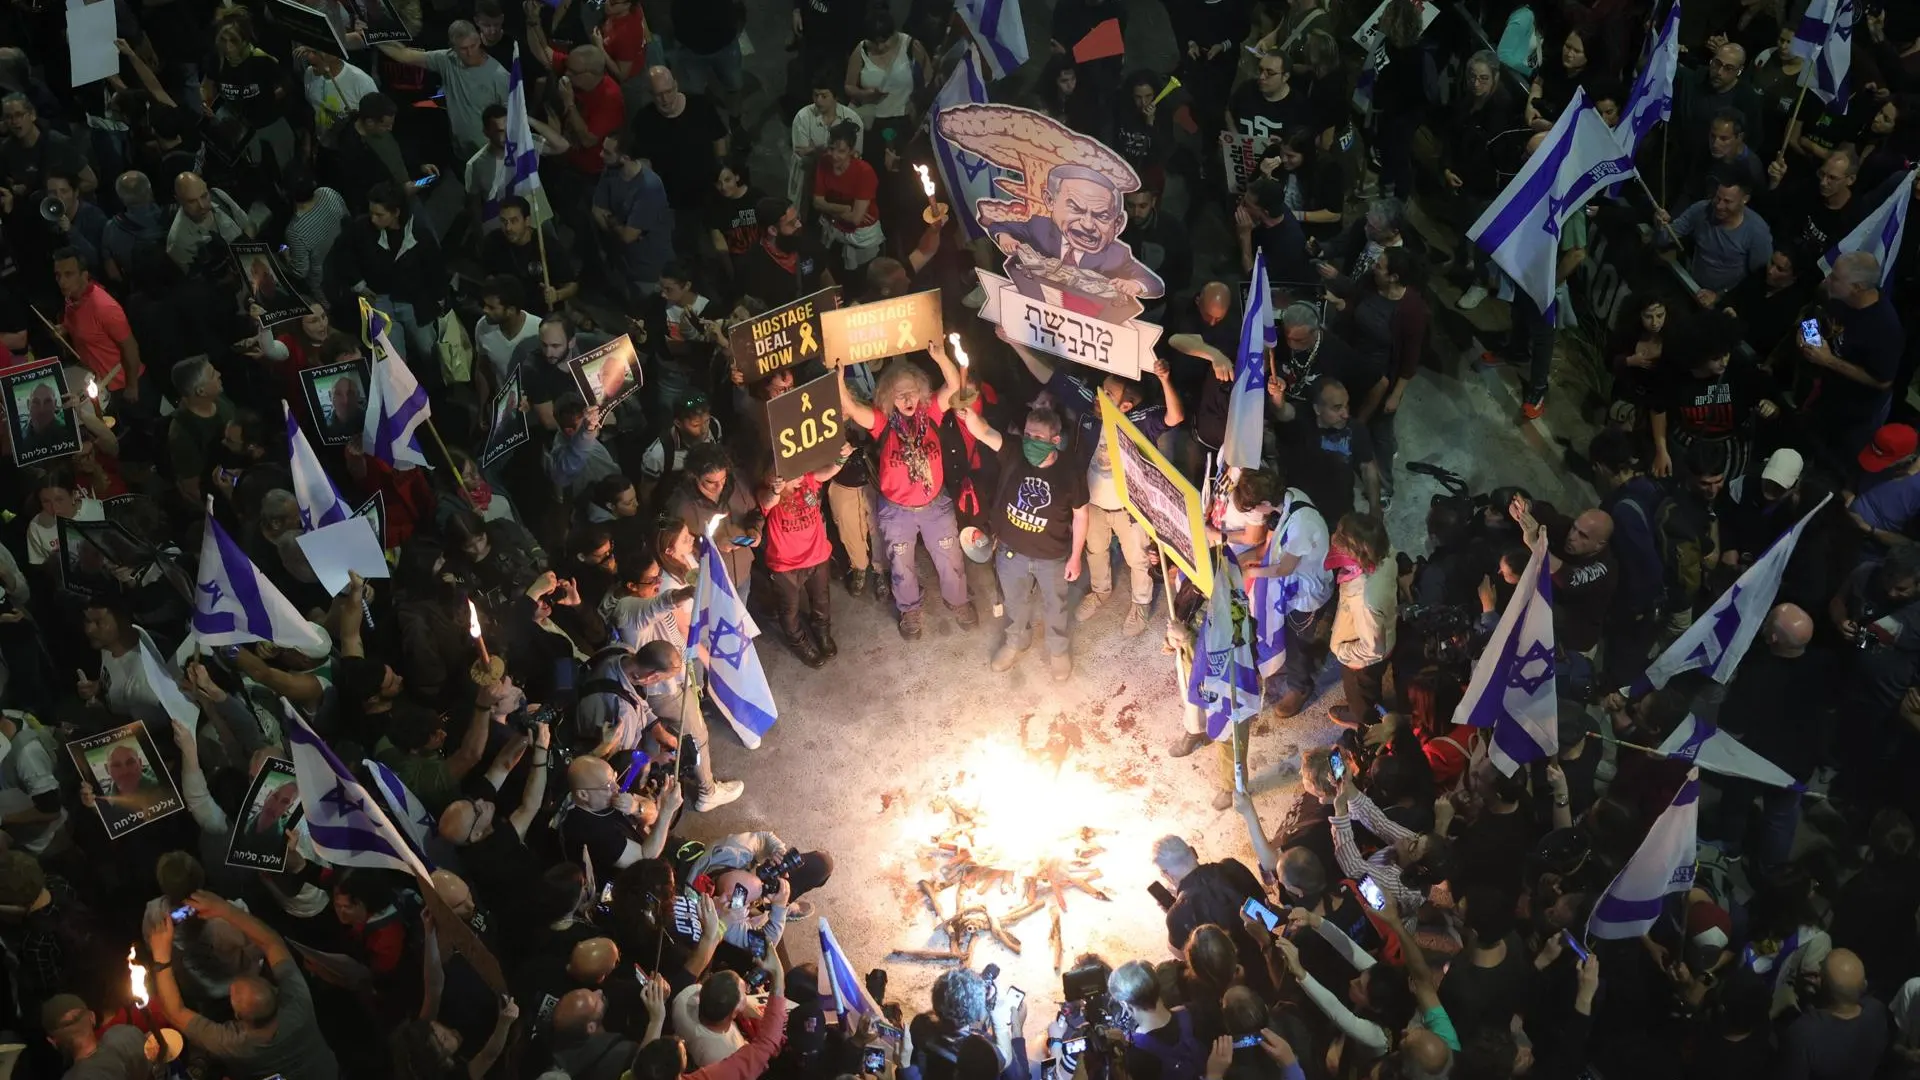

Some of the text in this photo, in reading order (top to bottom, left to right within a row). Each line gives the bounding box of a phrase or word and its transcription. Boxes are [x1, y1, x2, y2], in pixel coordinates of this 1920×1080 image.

[752, 302, 814, 340] HOSTAGE
[847, 301, 917, 329] HOSTAGE
[1024, 304, 1114, 347] מורשת
[755, 330, 792, 357] DEAL
[848, 325, 888, 346] DEAL
[1029, 323, 1109, 364] נתניהו
[758, 347, 793, 375] NOW
[849, 340, 888, 361] NOW
[779, 408, 838, 458] S.O.S
[21, 440, 76, 460] אלעד, סליחה
[1006, 502, 1048, 527] חובה
[1006, 511, 1045, 533] להתנגד
[94, 734, 111, 744] קציר
[112, 797, 176, 831] אלעד, סליחה
[233, 849, 282, 865] אלעד, סליחה
